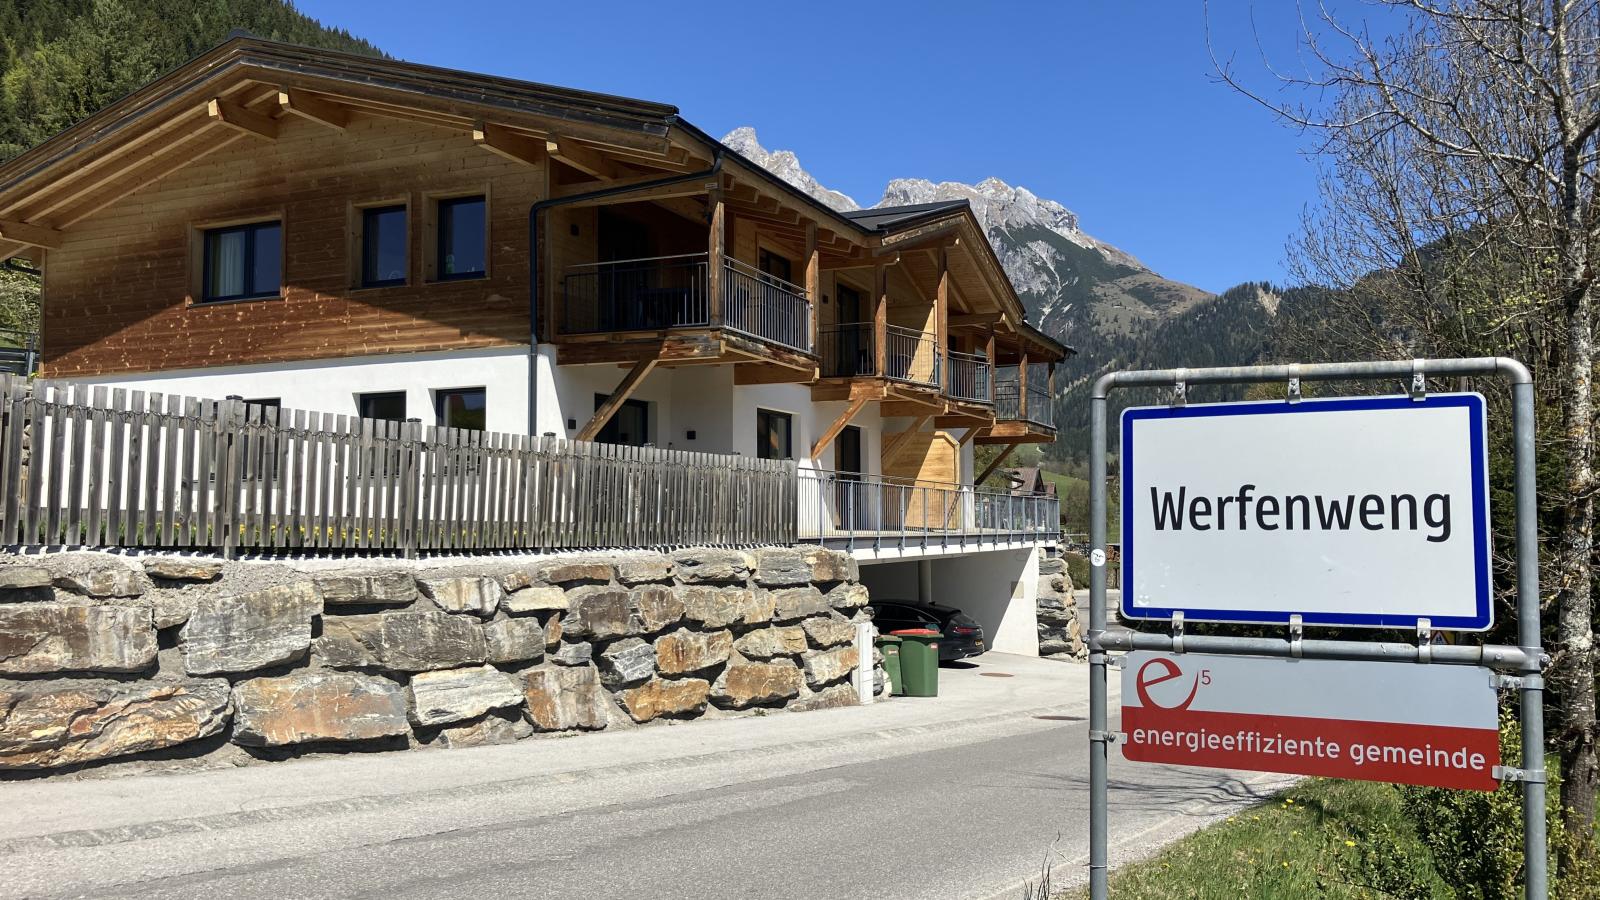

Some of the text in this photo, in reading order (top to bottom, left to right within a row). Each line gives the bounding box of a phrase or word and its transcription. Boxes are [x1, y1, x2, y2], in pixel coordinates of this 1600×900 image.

[1151, 485, 1451, 542] Werfenweng
[1133, 728, 1485, 770] energieeffiziente gemeinde
